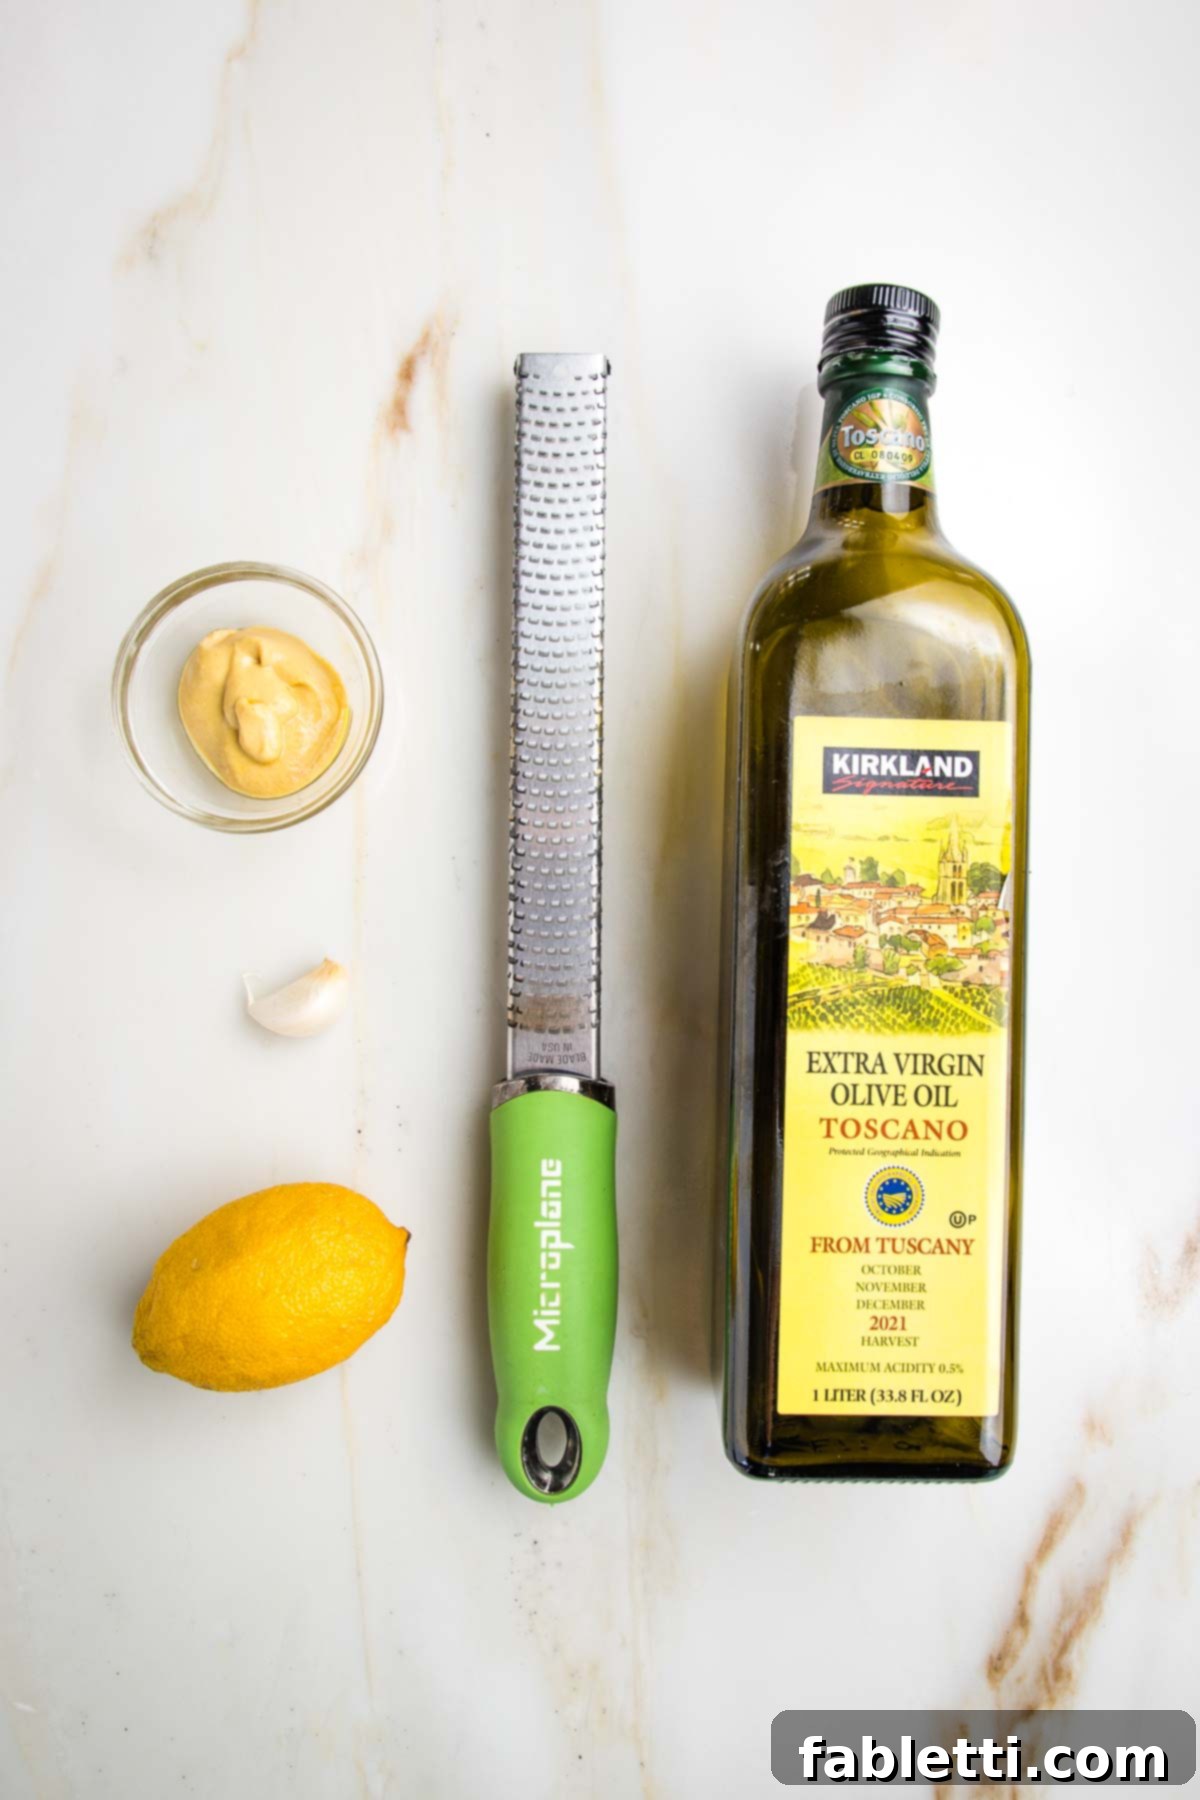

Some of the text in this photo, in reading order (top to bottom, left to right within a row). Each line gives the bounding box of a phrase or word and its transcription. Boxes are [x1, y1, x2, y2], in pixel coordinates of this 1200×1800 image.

[841, 425, 925, 451] Toscano
[853, 450, 865, 460] CL
[832, 753, 973, 778] KIRKLAND
[832, 774, 973, 796] Signature
[806, 1051, 985, 1077] EXTRA VIRGIN
[831, 1083, 958, 1107] OLIVE OIL
[819, 1118, 968, 1141] TOSCANO
[829, 1147, 961, 1158] Protected Geographical Indication
[533, 1158, 575, 1351] Microplane
[809, 1236, 975, 1255] FROM TUSCANY
[861, 1264, 921, 1276] OCTOBER
[855, 1282, 927, 1293] NOVEMBER
[856, 1299, 925, 1310] DECEMBER
[869, 1315, 907, 1331] 2021
[861, 1336, 920, 1347] HARVEST
[815, 1361, 964, 1374] MAXIMUM ACIDITY 0.5%
[813, 1387, 962, 1407] 1 LITER (33.8 FL OZ)
